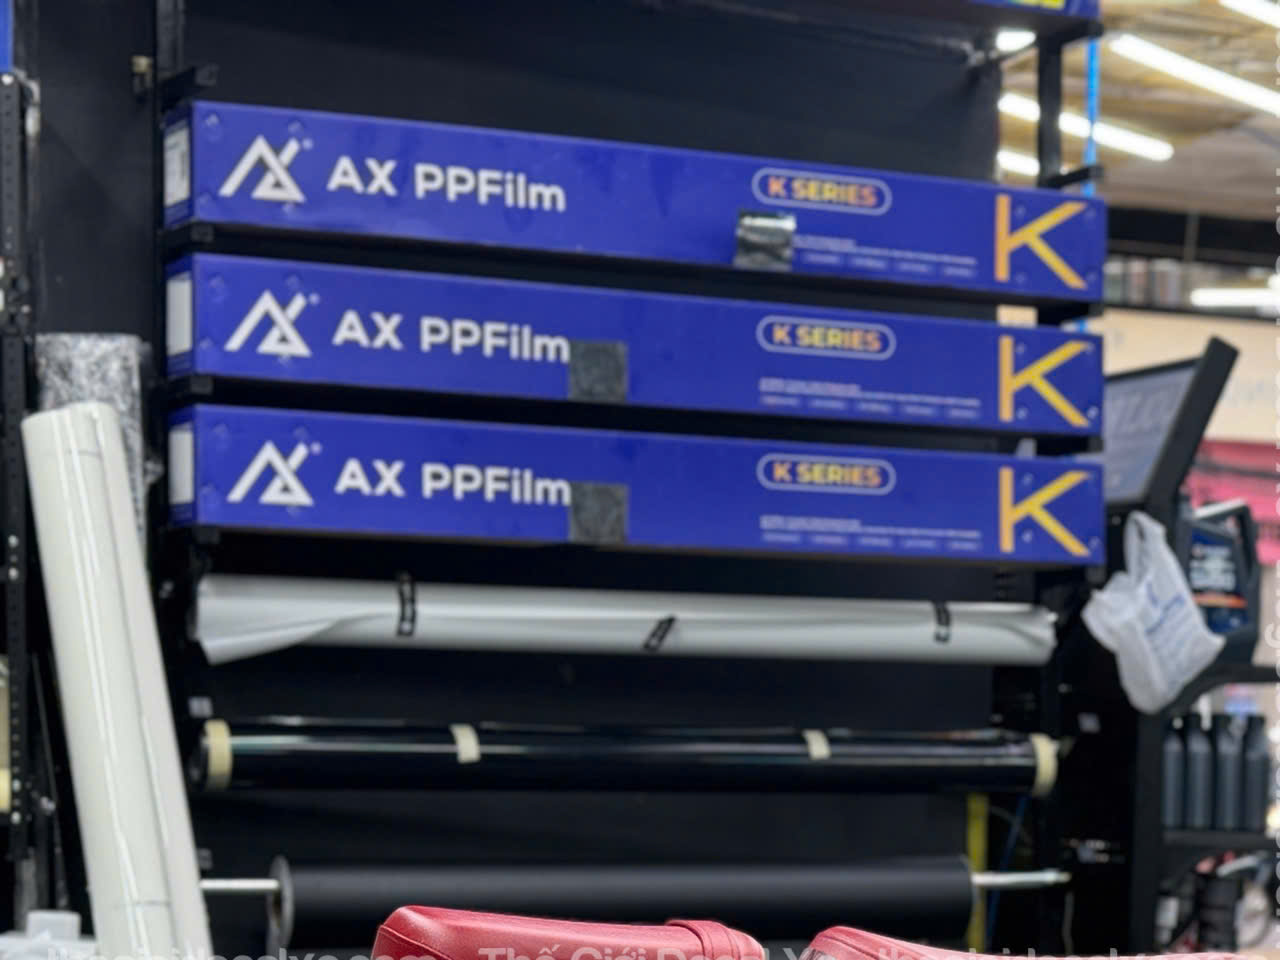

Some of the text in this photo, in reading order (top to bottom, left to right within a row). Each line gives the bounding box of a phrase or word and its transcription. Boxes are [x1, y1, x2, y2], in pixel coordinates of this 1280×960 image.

[327, 156, 566, 212] AX PPFilm
[767, 177, 877, 207] K SERIES
[995, 193, 1088, 290] K
[332, 310, 571, 364] AX PPFilm
[773, 325, 881, 352] K SERIES
[999, 334, 1091, 428] K
[335, 458, 571, 506] AX PPFilm
[773, 463, 881, 488] K SERIES
[1000, 466, 1091, 557] K
